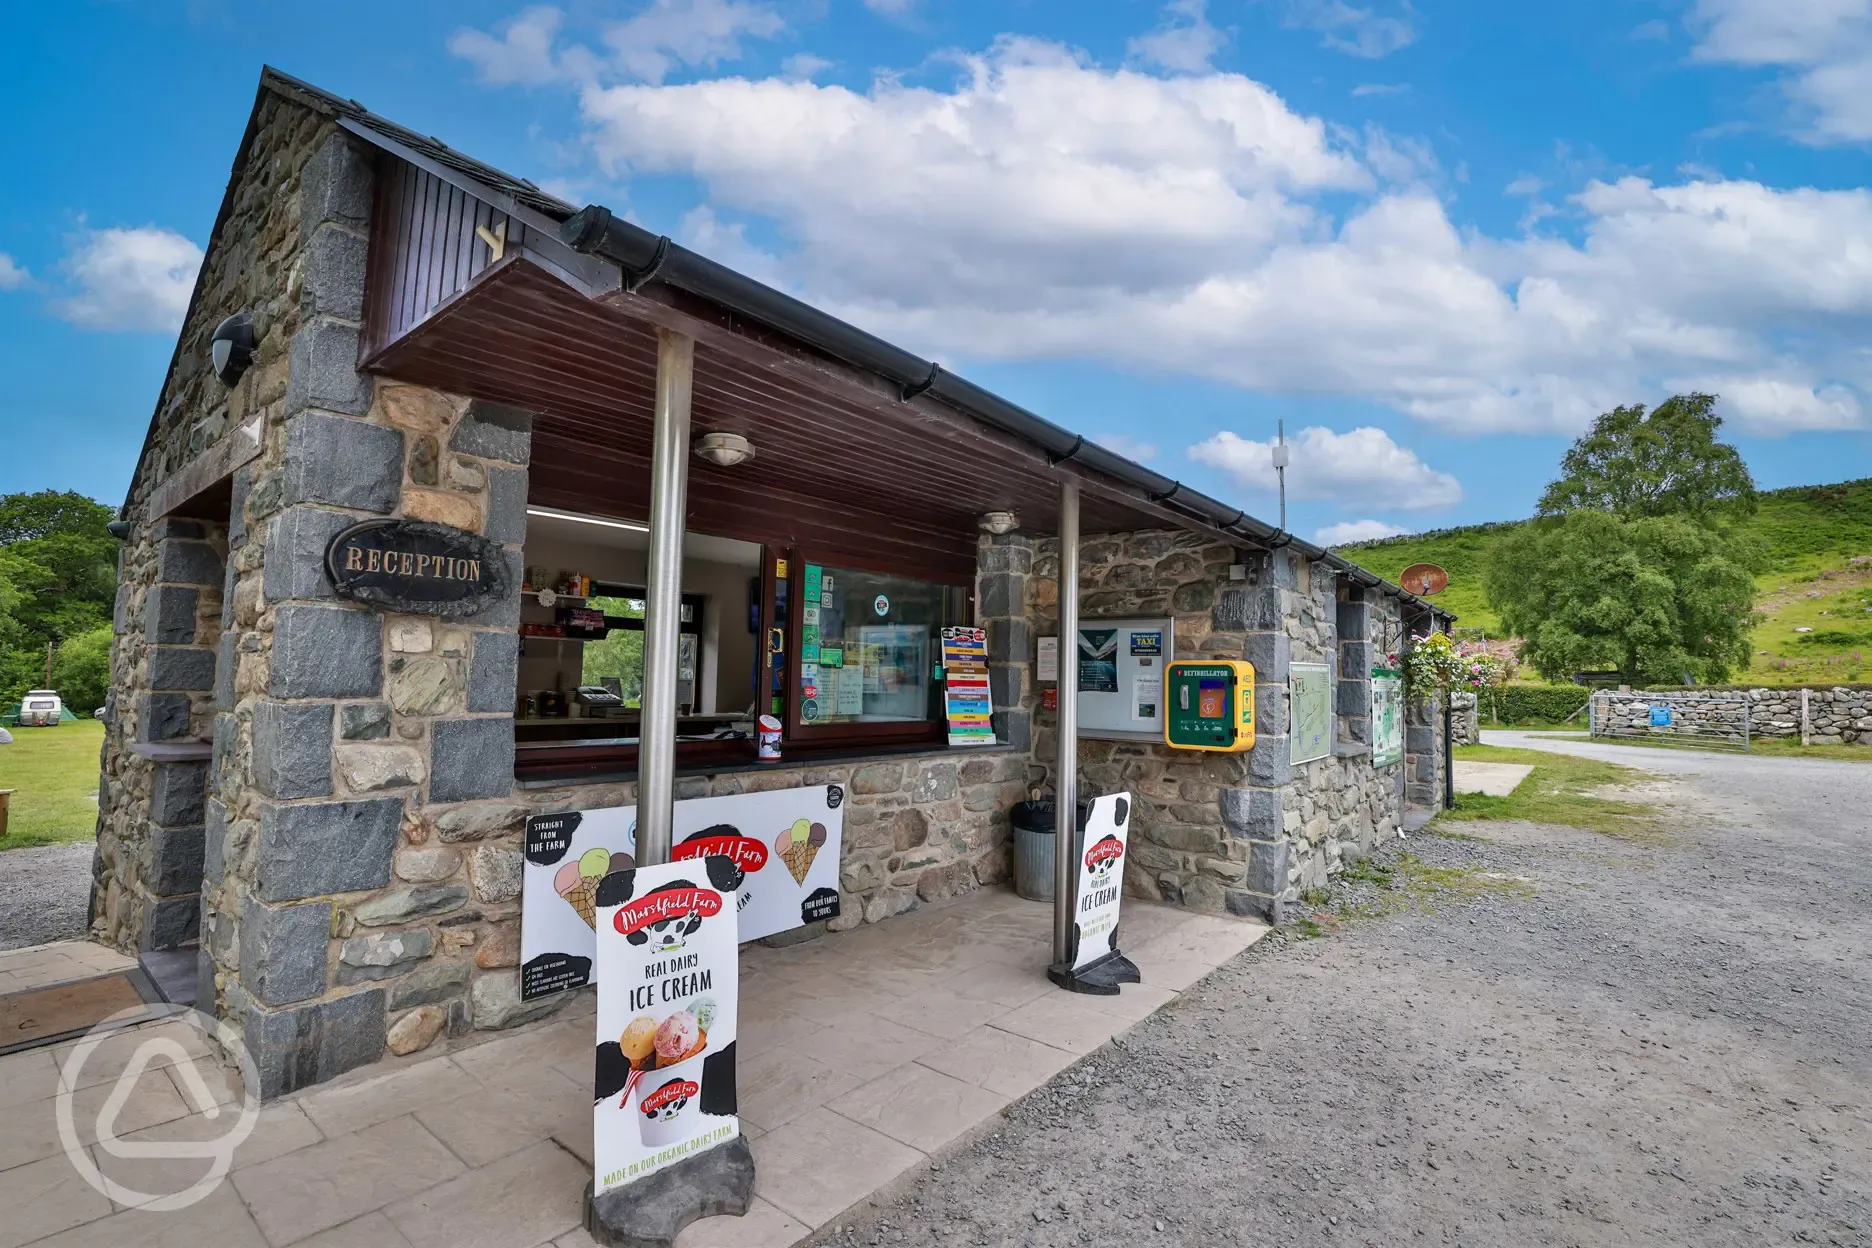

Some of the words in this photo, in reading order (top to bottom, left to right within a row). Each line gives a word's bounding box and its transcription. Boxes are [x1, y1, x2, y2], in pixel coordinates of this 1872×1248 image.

[346, 547, 481, 582] RECEPTION
[534, 820, 564, 831] STRAIGHT
[540, 831, 556, 840] FROM
[530, 842, 544, 852] THE
[546, 840, 566, 851] FARM
[735, 841, 762, 863] Farm
[621, 892, 690, 931] Marshfield
[692, 892, 717, 910] Farm
[1082, 894, 1093, 912] ICE
[1094, 885, 1118, 908] CREAM
[645, 960, 668, 980] REAL
[670, 953, 698, 973] DAIRY
[630, 984, 654, 1012] ICE
[662, 968, 712, 1002] CREAM
[644, 1084, 682, 1111] Marshfield
[604, 1168, 626, 1186] MADE
[628, 1162, 638, 1176] ON
[640, 1156, 656, 1171] OUR
[658, 1141, 688, 1164] ORGANIC
[690, 1132, 712, 1150] DAIRY
[714, 1124, 732, 1141] FARM
